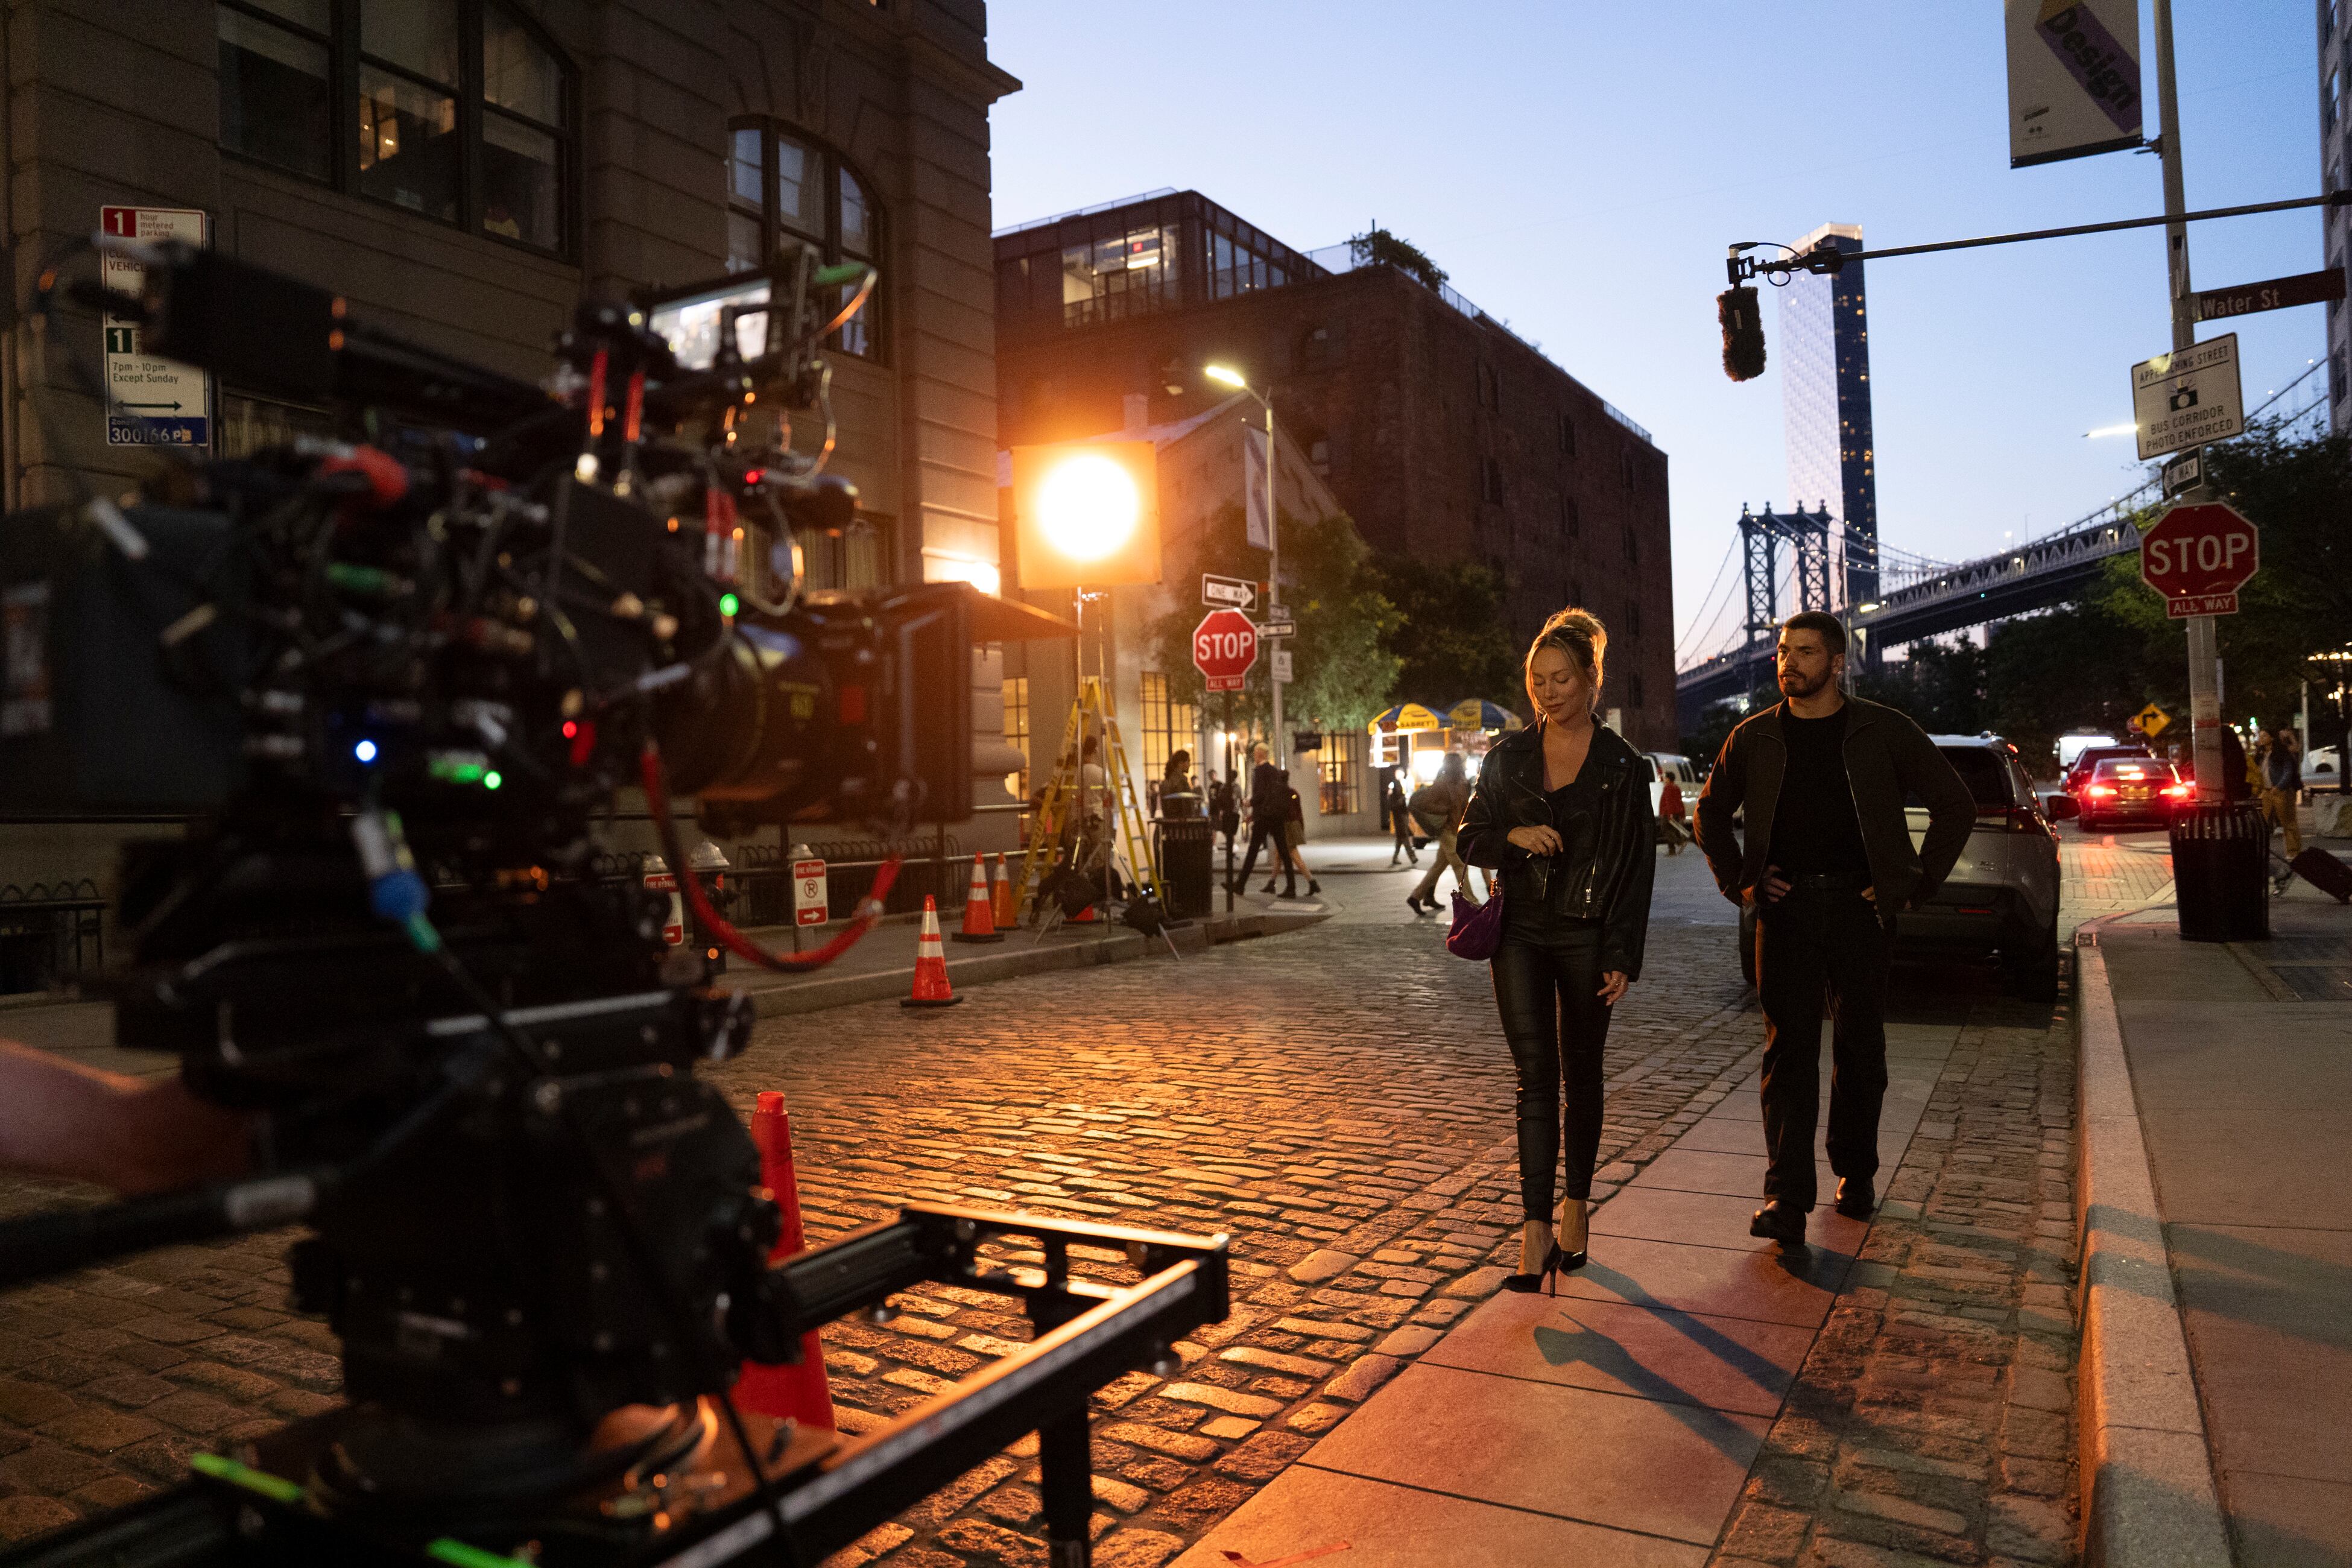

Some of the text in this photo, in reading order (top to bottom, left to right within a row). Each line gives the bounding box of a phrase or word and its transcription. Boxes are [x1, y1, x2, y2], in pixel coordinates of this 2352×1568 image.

[2045, 7, 2136, 111] Design
[114, 212, 124, 235] 1
[141, 221, 174, 230] metered
[141, 229, 170, 238] parking
[109, 261, 146, 272] VEHICL
[2202, 289, 2280, 318] Water St
[114, 329, 124, 352] 1
[2197, 346, 2228, 365] STREET
[113, 362, 133, 373] 7pm
[113, 373, 179, 384] Except Sunday
[2150, 405, 2224, 435] BUS CORRIDOR
[2146, 419, 2233, 452] PHOTO ENFORCED
[2179, 461, 2194, 481] WAY
[2149, 533, 2249, 575] STOP
[1211, 585, 1248, 600] ONE WAY
[2173, 598, 2231, 613] ALL WAY
[1198, 631, 1253, 661] STOP
[1209, 678, 1242, 688] ALL WAY
